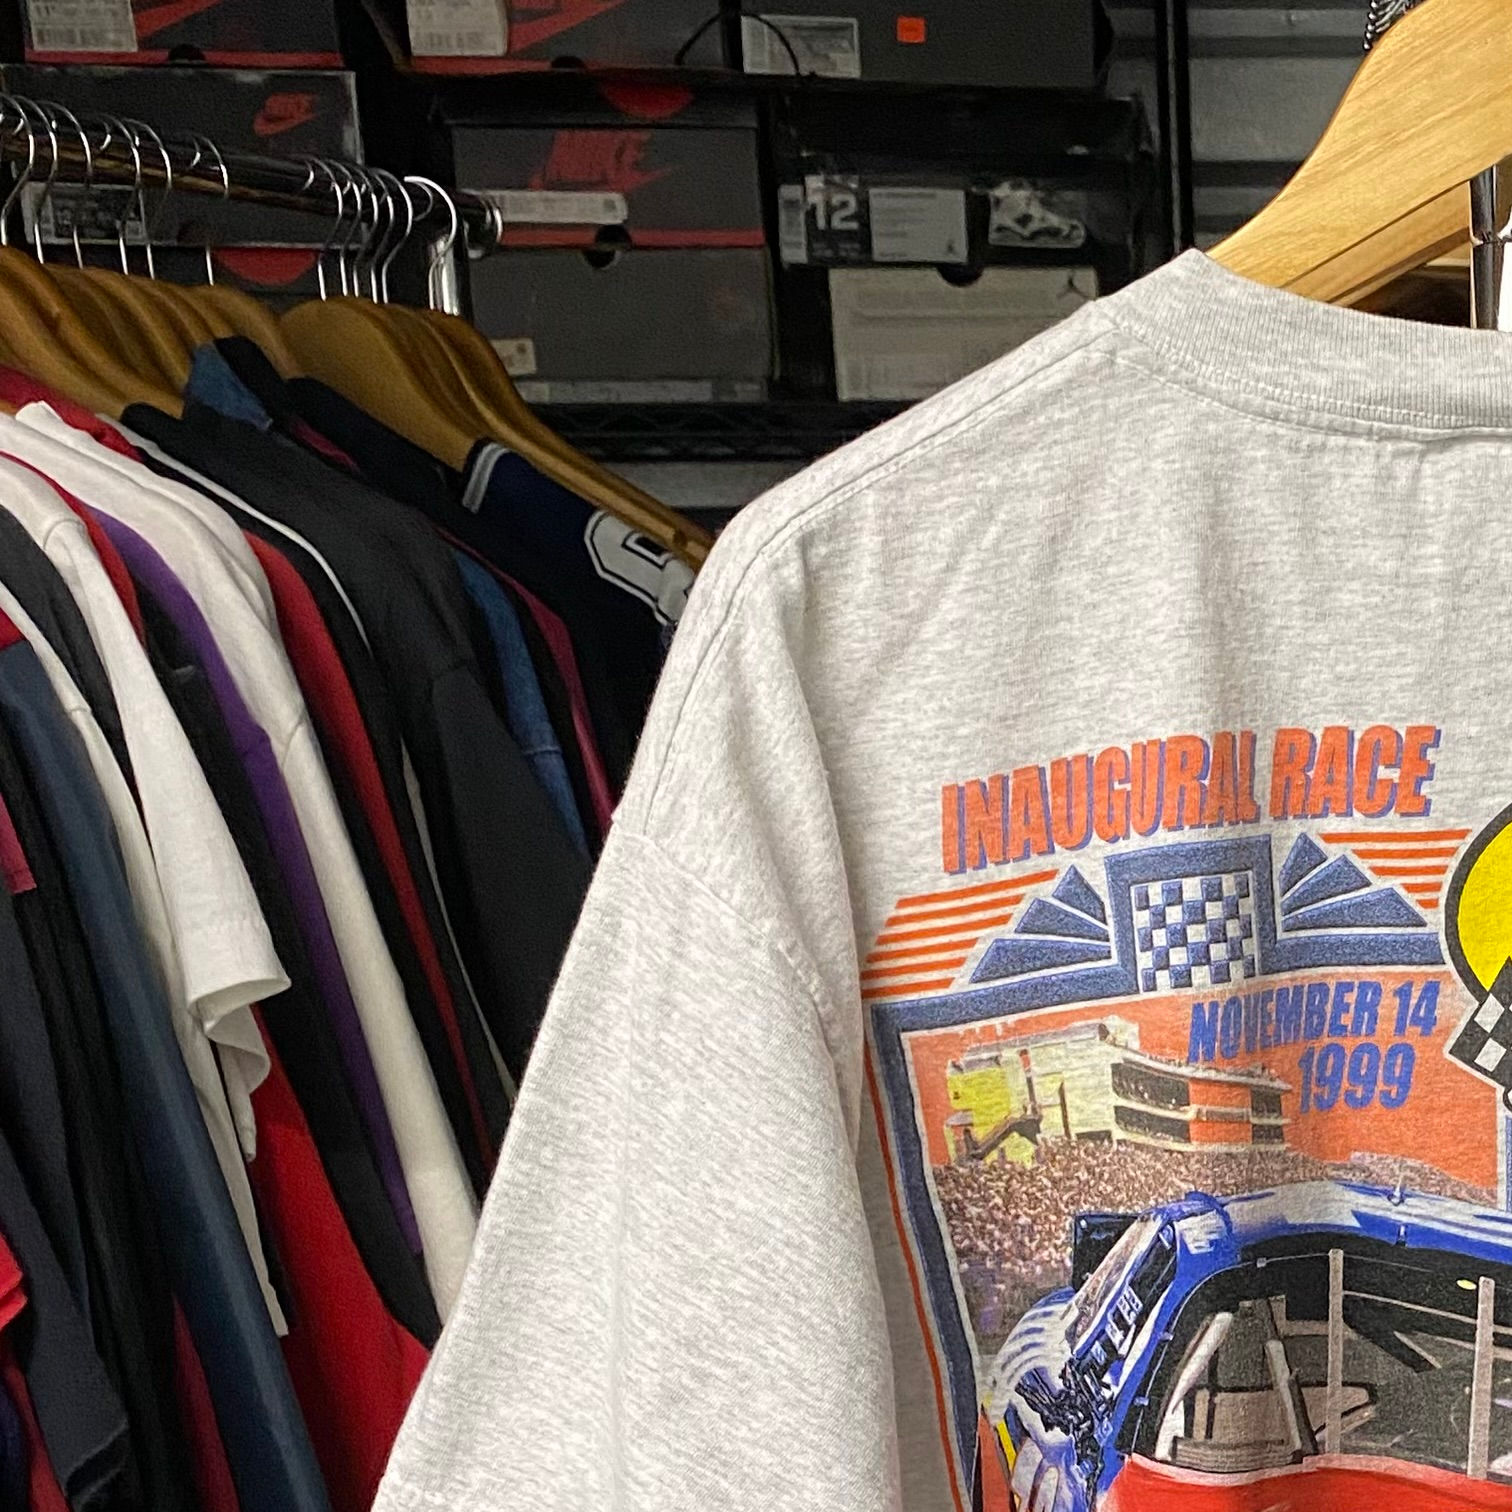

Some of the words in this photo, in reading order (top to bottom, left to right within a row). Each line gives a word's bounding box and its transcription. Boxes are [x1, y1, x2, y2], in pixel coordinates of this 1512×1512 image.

[807, 193, 859, 230] 12
[942, 730, 1260, 875] INAUGURAL
[1270, 725, 1442, 820] RACE
[1189, 982, 1384, 1062] NOVEMBER
[1392, 980, 1441, 1037] 14
[1298, 1043, 1417, 1114] 1999
